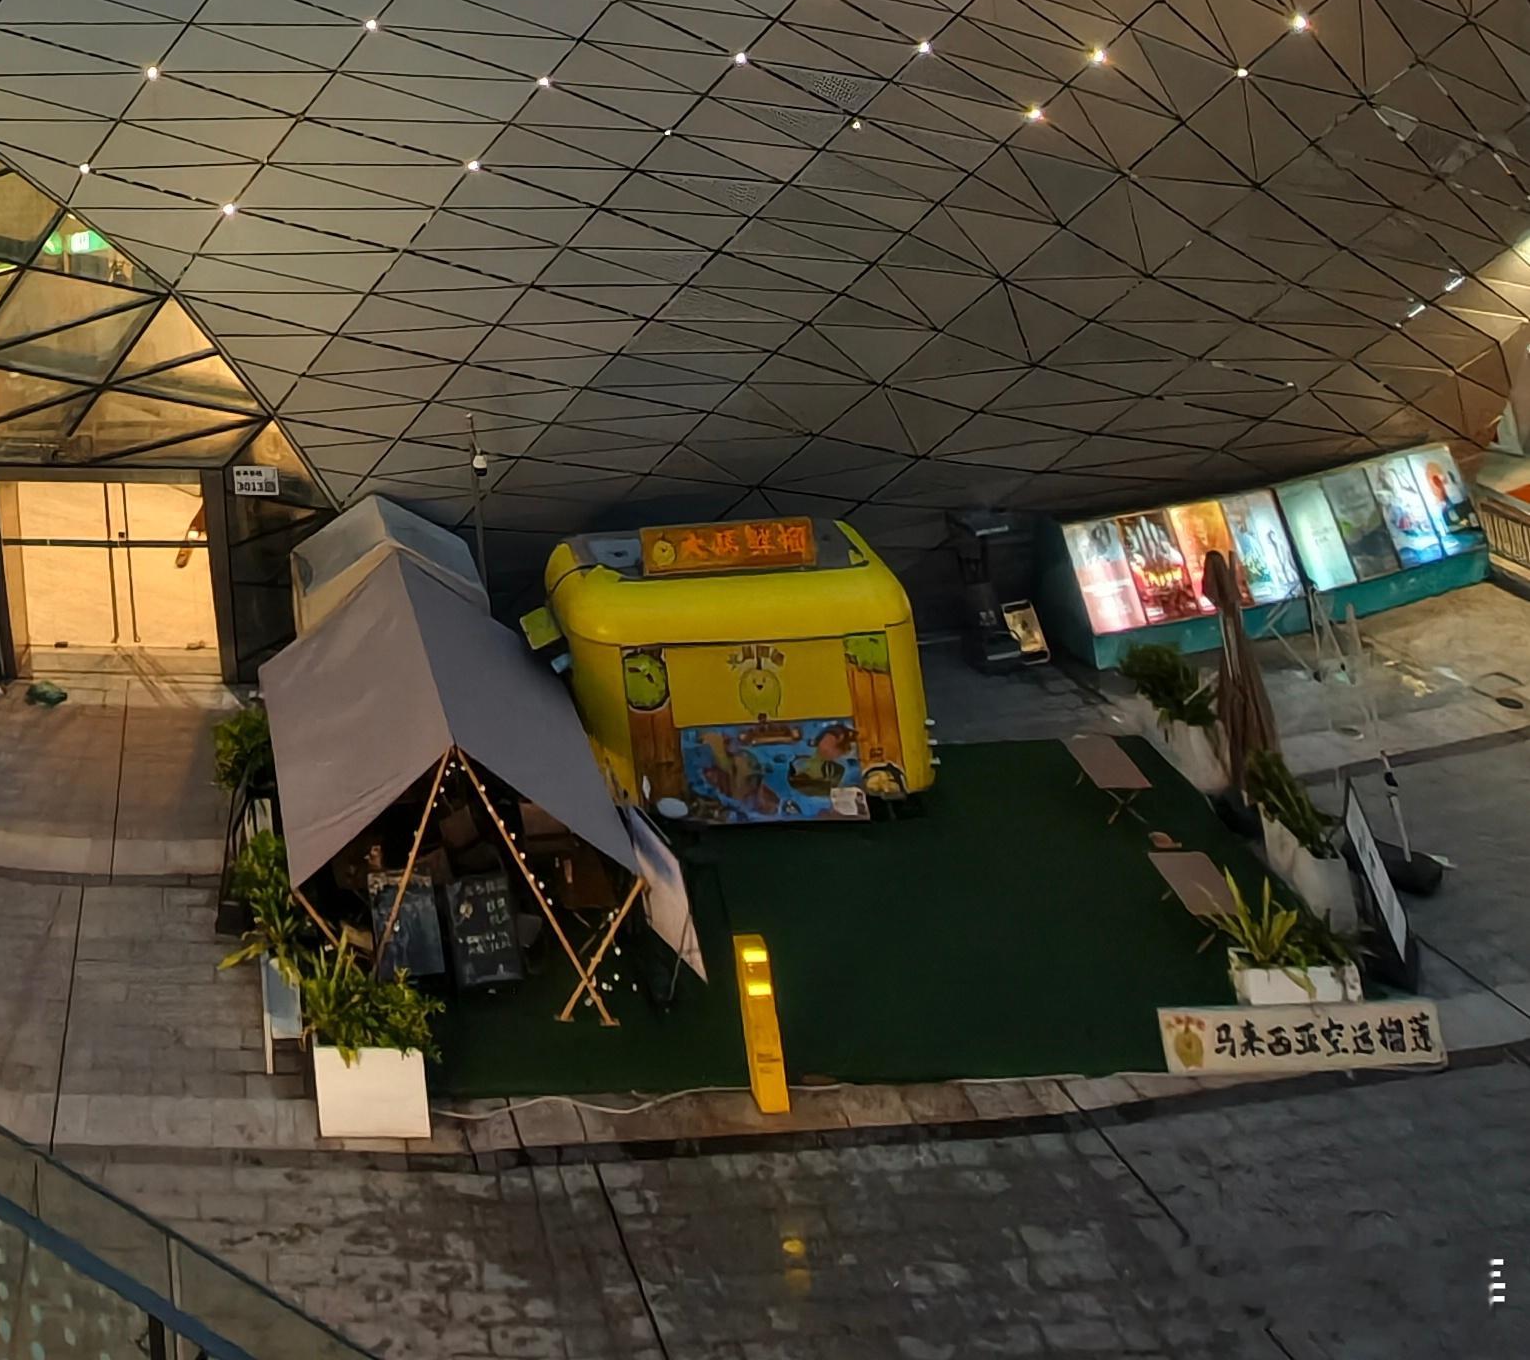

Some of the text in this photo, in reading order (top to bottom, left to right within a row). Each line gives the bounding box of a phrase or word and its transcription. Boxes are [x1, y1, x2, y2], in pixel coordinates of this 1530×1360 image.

[1214, 1011, 1434, 1059] 马来西亚空运榴莲
